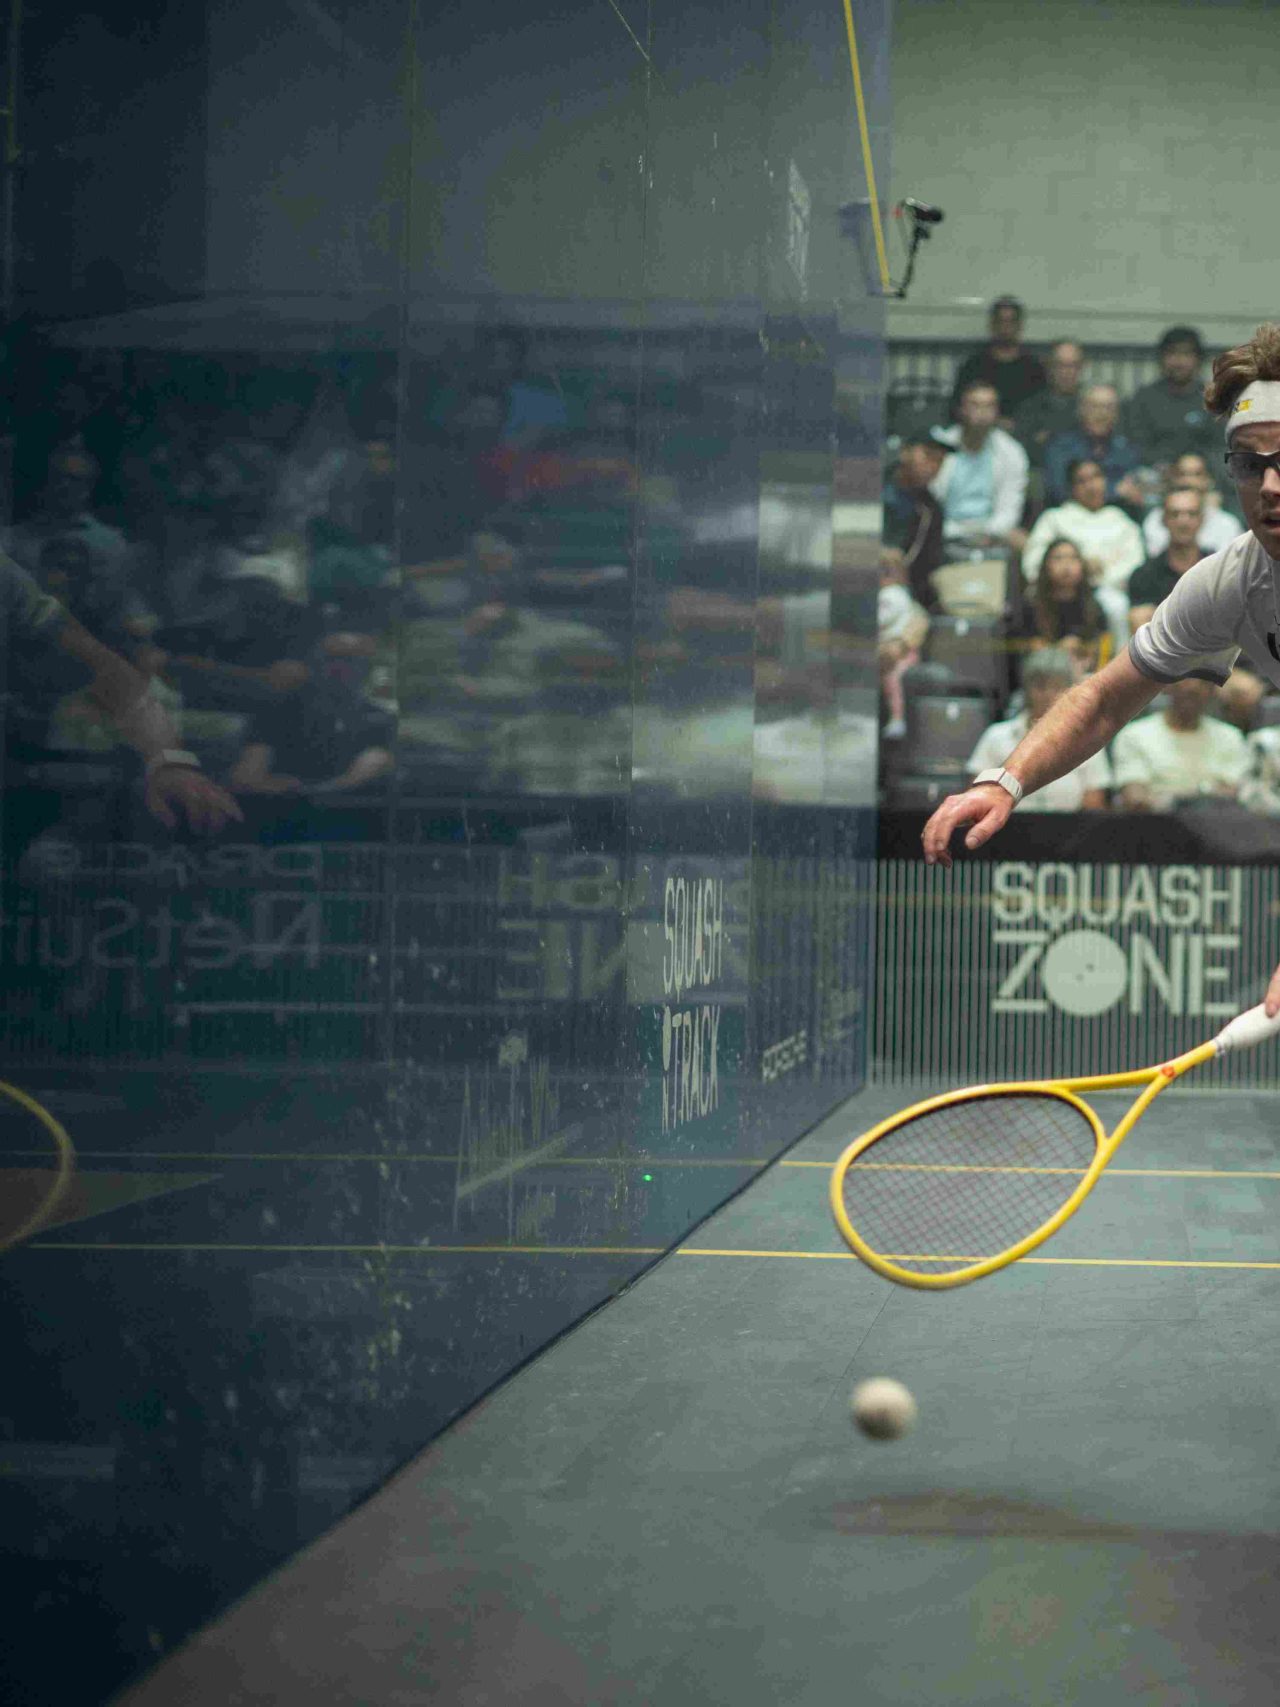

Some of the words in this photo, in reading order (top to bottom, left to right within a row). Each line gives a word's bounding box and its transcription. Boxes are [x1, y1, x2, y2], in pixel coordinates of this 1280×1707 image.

[663, 878, 723, 1003] SQUASH
[993, 862, 1242, 930] SQUASH
[992, 929, 1241, 1017] ZONE
[672, 1004, 721, 1129] TRACK
